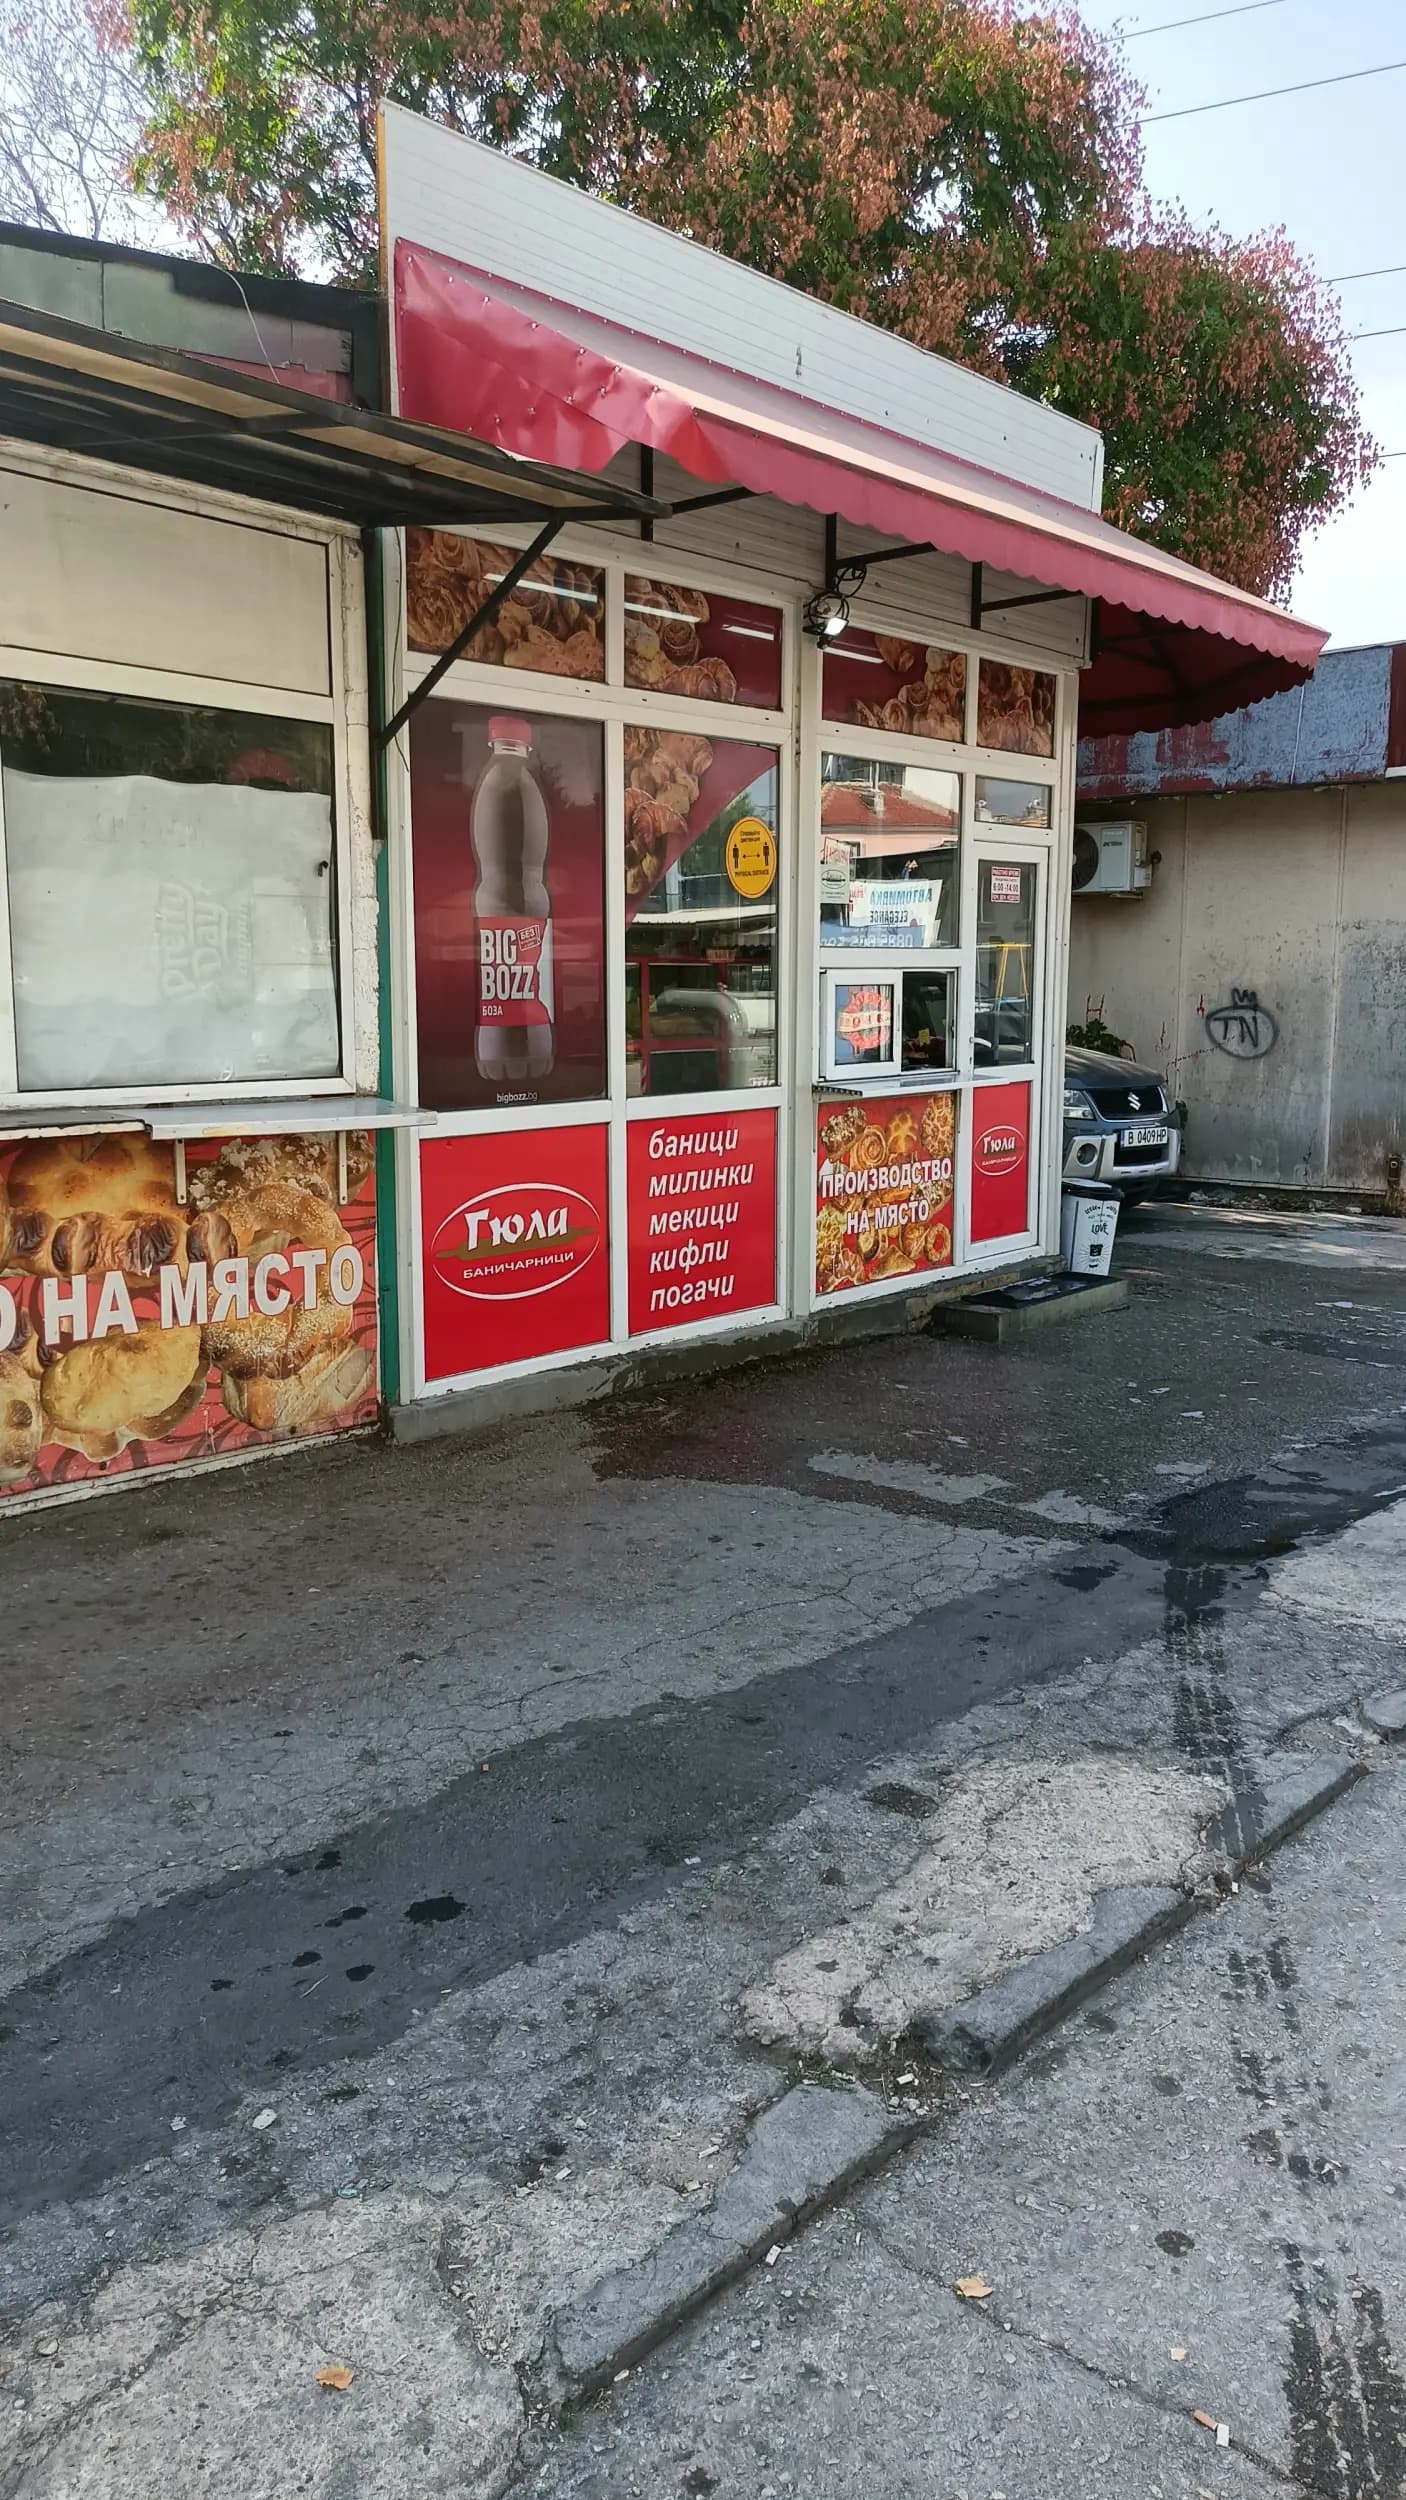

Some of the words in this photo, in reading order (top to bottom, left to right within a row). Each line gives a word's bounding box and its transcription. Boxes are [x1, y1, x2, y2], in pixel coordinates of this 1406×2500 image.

[480, 929, 517, 965] BIG
[481, 965, 535, 1001] BOZZ
[482, 1004, 503, 1017] БОЗА
[496, 1091, 538, 1104] bigbozz.bg
[648, 1128, 739, 1160] баници
[983, 1136, 1016, 1154] Гюла
[648, 1162, 754, 1199] милинки
[821, 1158, 952, 1199] ПРОИЗВОДСТВО
[464, 1206, 569, 1251] Гюла
[648, 1201, 739, 1236] мекици
[847, 1211, 870, 1235] НА
[874, 1200, 930, 1230] МЯСТО
[463, 1252, 574, 1279] БАНИЧАРНИЦИ
[649, 1238, 730, 1275] кифли
[43, 1270, 140, 1346] НА
[160, 1244, 364, 1330] МЯСТО
[650, 1274, 735, 1312] погачи
